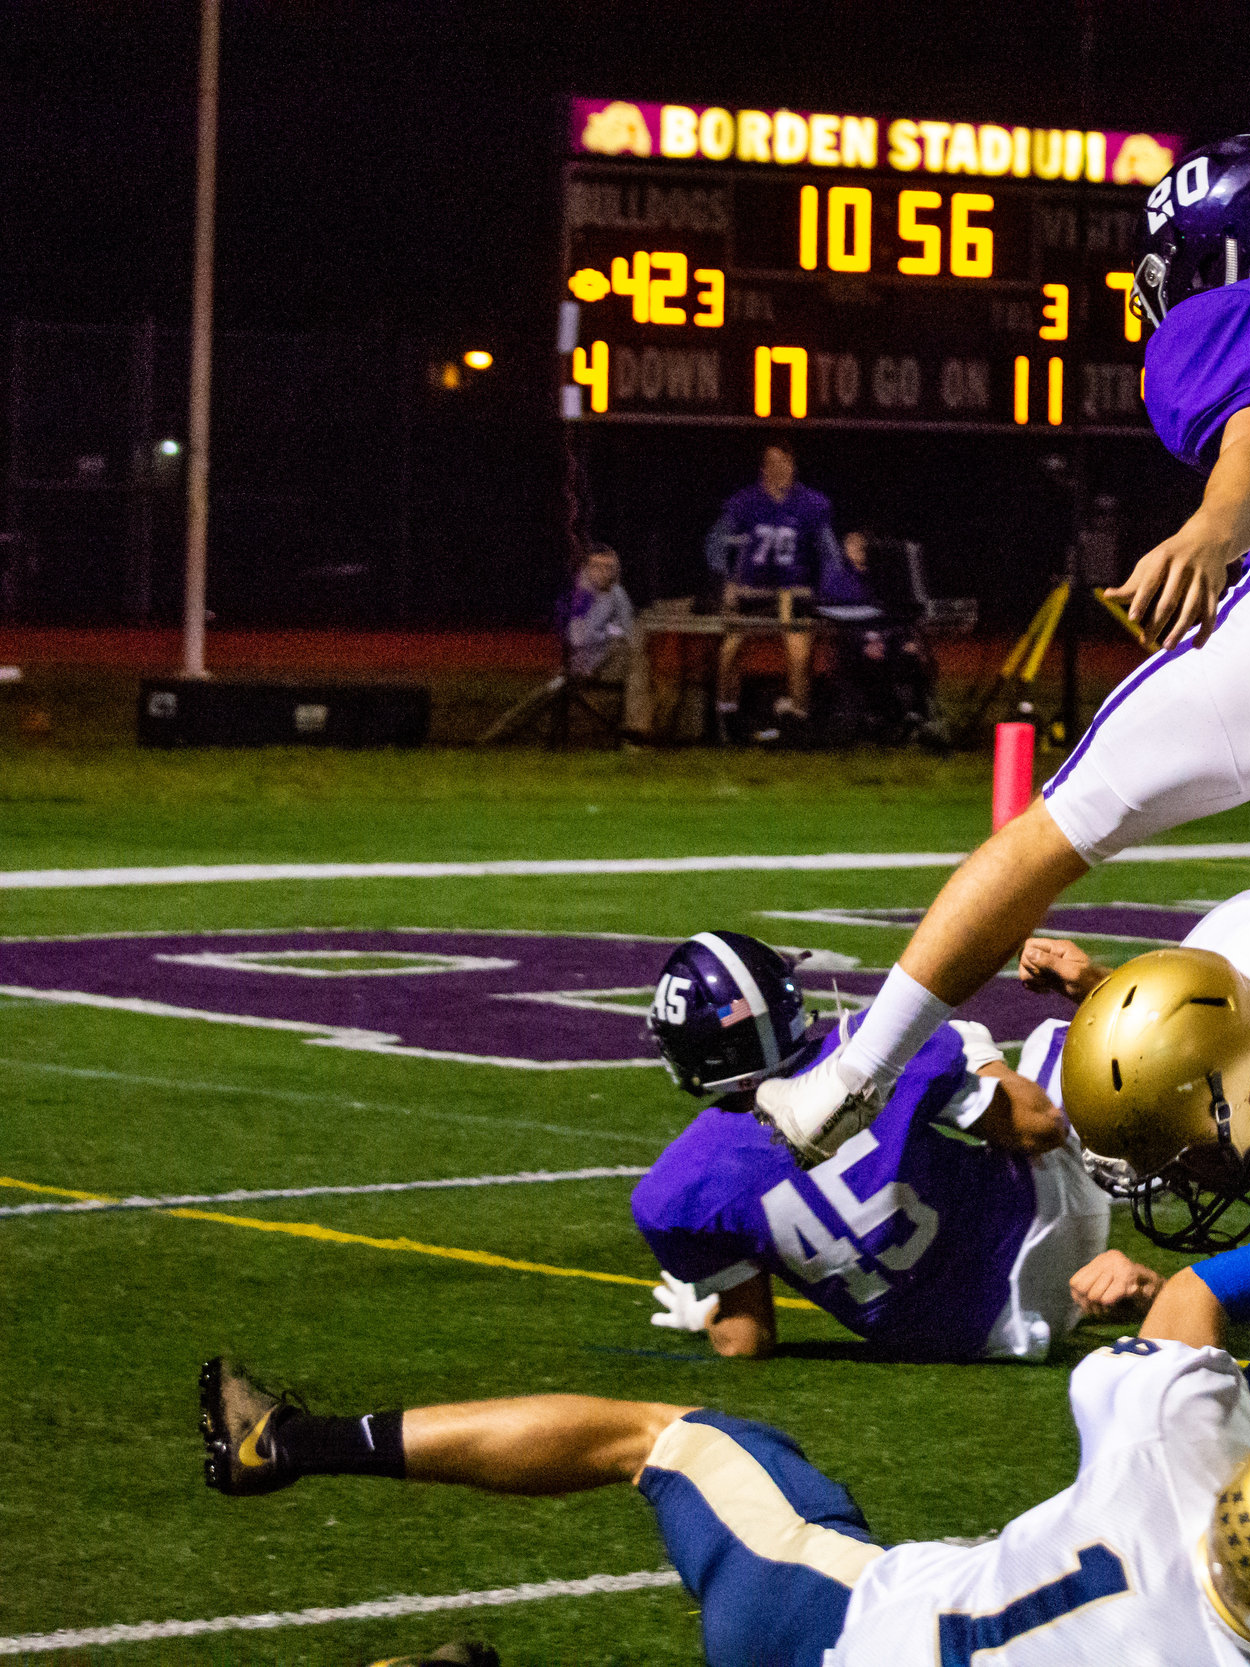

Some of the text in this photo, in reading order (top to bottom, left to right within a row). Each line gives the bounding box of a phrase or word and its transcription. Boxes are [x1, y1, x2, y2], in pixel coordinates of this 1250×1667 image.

[660, 104, 1107, 184] BORDEN STADIUM
[799, 185, 995, 278] 10 56
[1147, 156, 1210, 235] 20
[1038, 282, 1071, 342] 3
[571, 339, 611, 414] 4
[616, 347, 720, 400] DOWN
[754, 344, 809, 419] 17
[815, 352, 861, 405] TO
[873, 356, 920, 407] GO
[941, 358, 990, 407] ON
[1013, 354, 1064, 426] 11
[655, 973, 693, 1025] 45
[761, 1128, 940, 1304] 45
